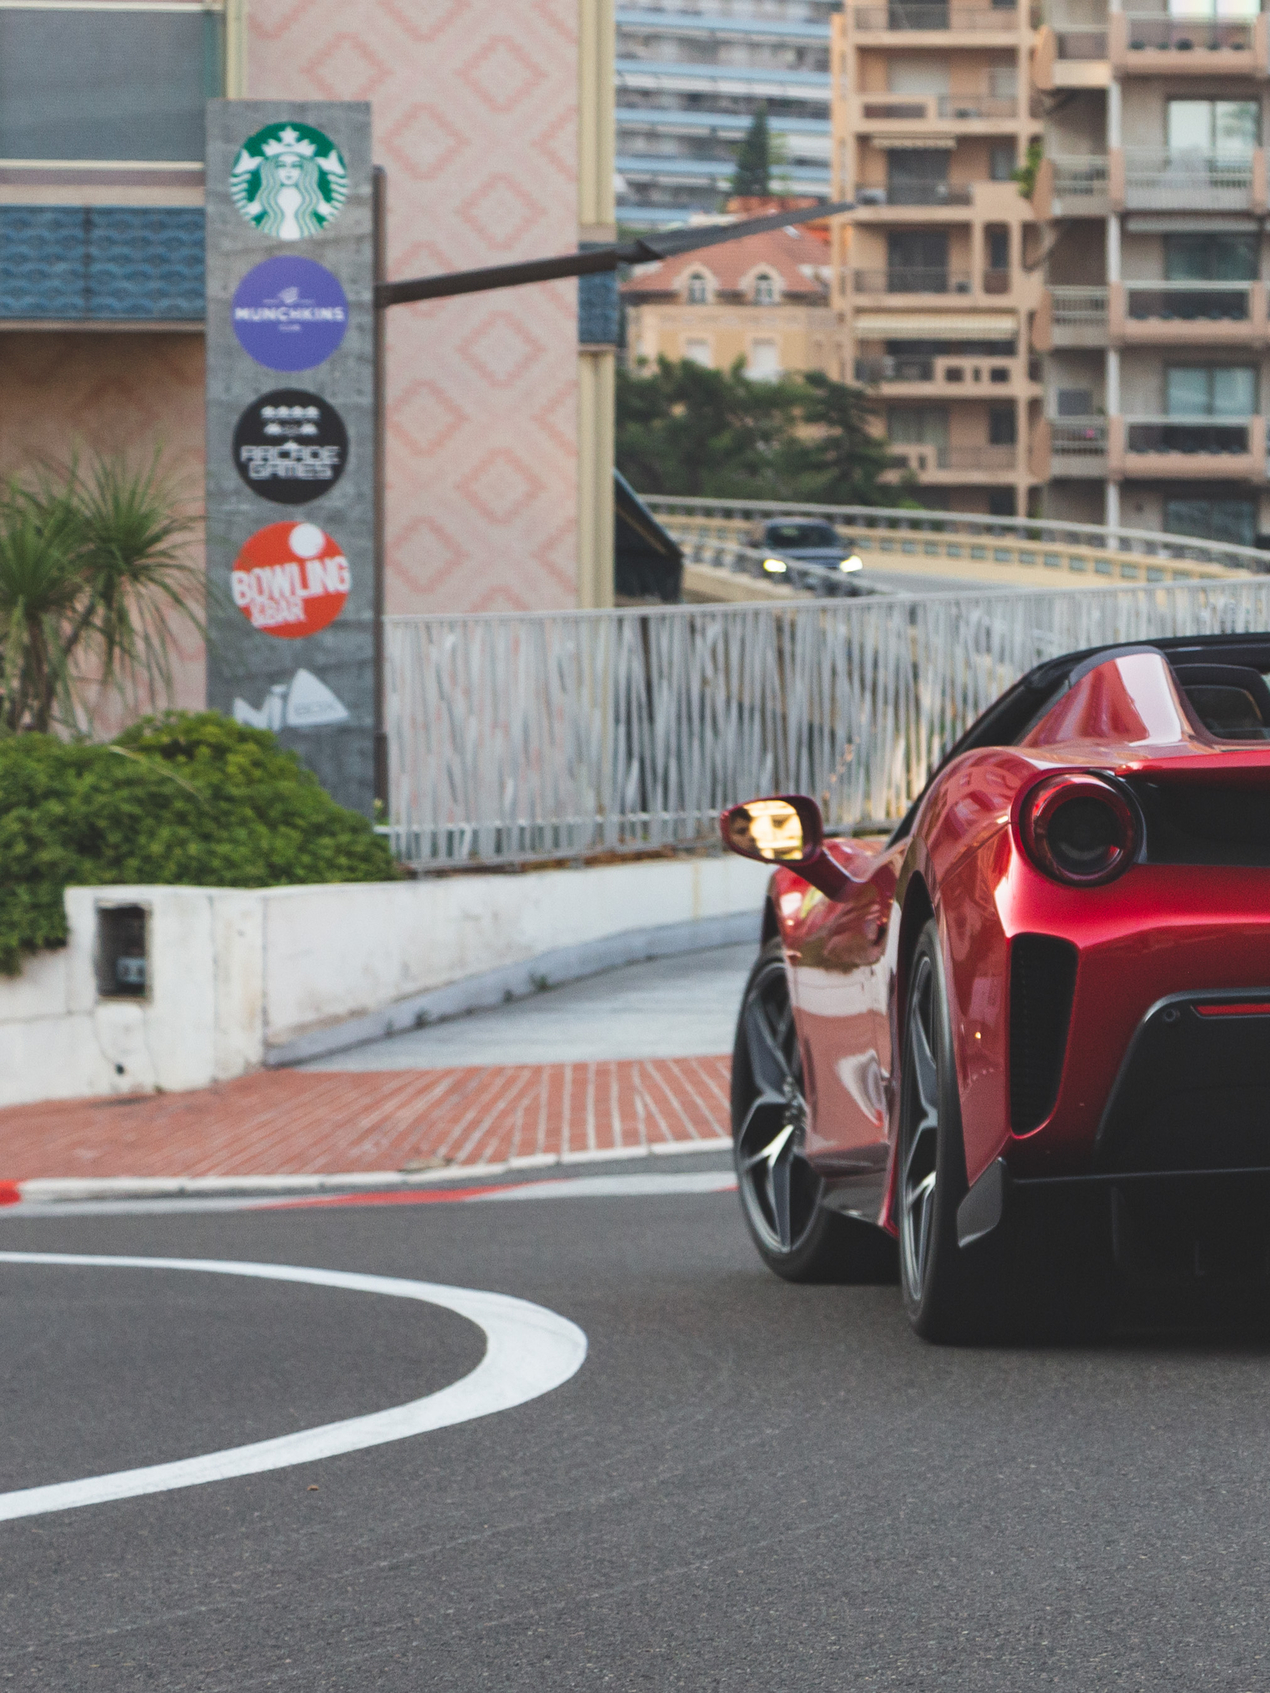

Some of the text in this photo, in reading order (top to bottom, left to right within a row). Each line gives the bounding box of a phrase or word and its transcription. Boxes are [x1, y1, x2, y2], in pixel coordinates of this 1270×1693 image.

[234, 306, 345, 322] MUNCHKINS
[241, 445, 341, 464] ARCADE
[248, 461, 333, 480] GAMES
[231, 555, 351, 608] BOWLING
